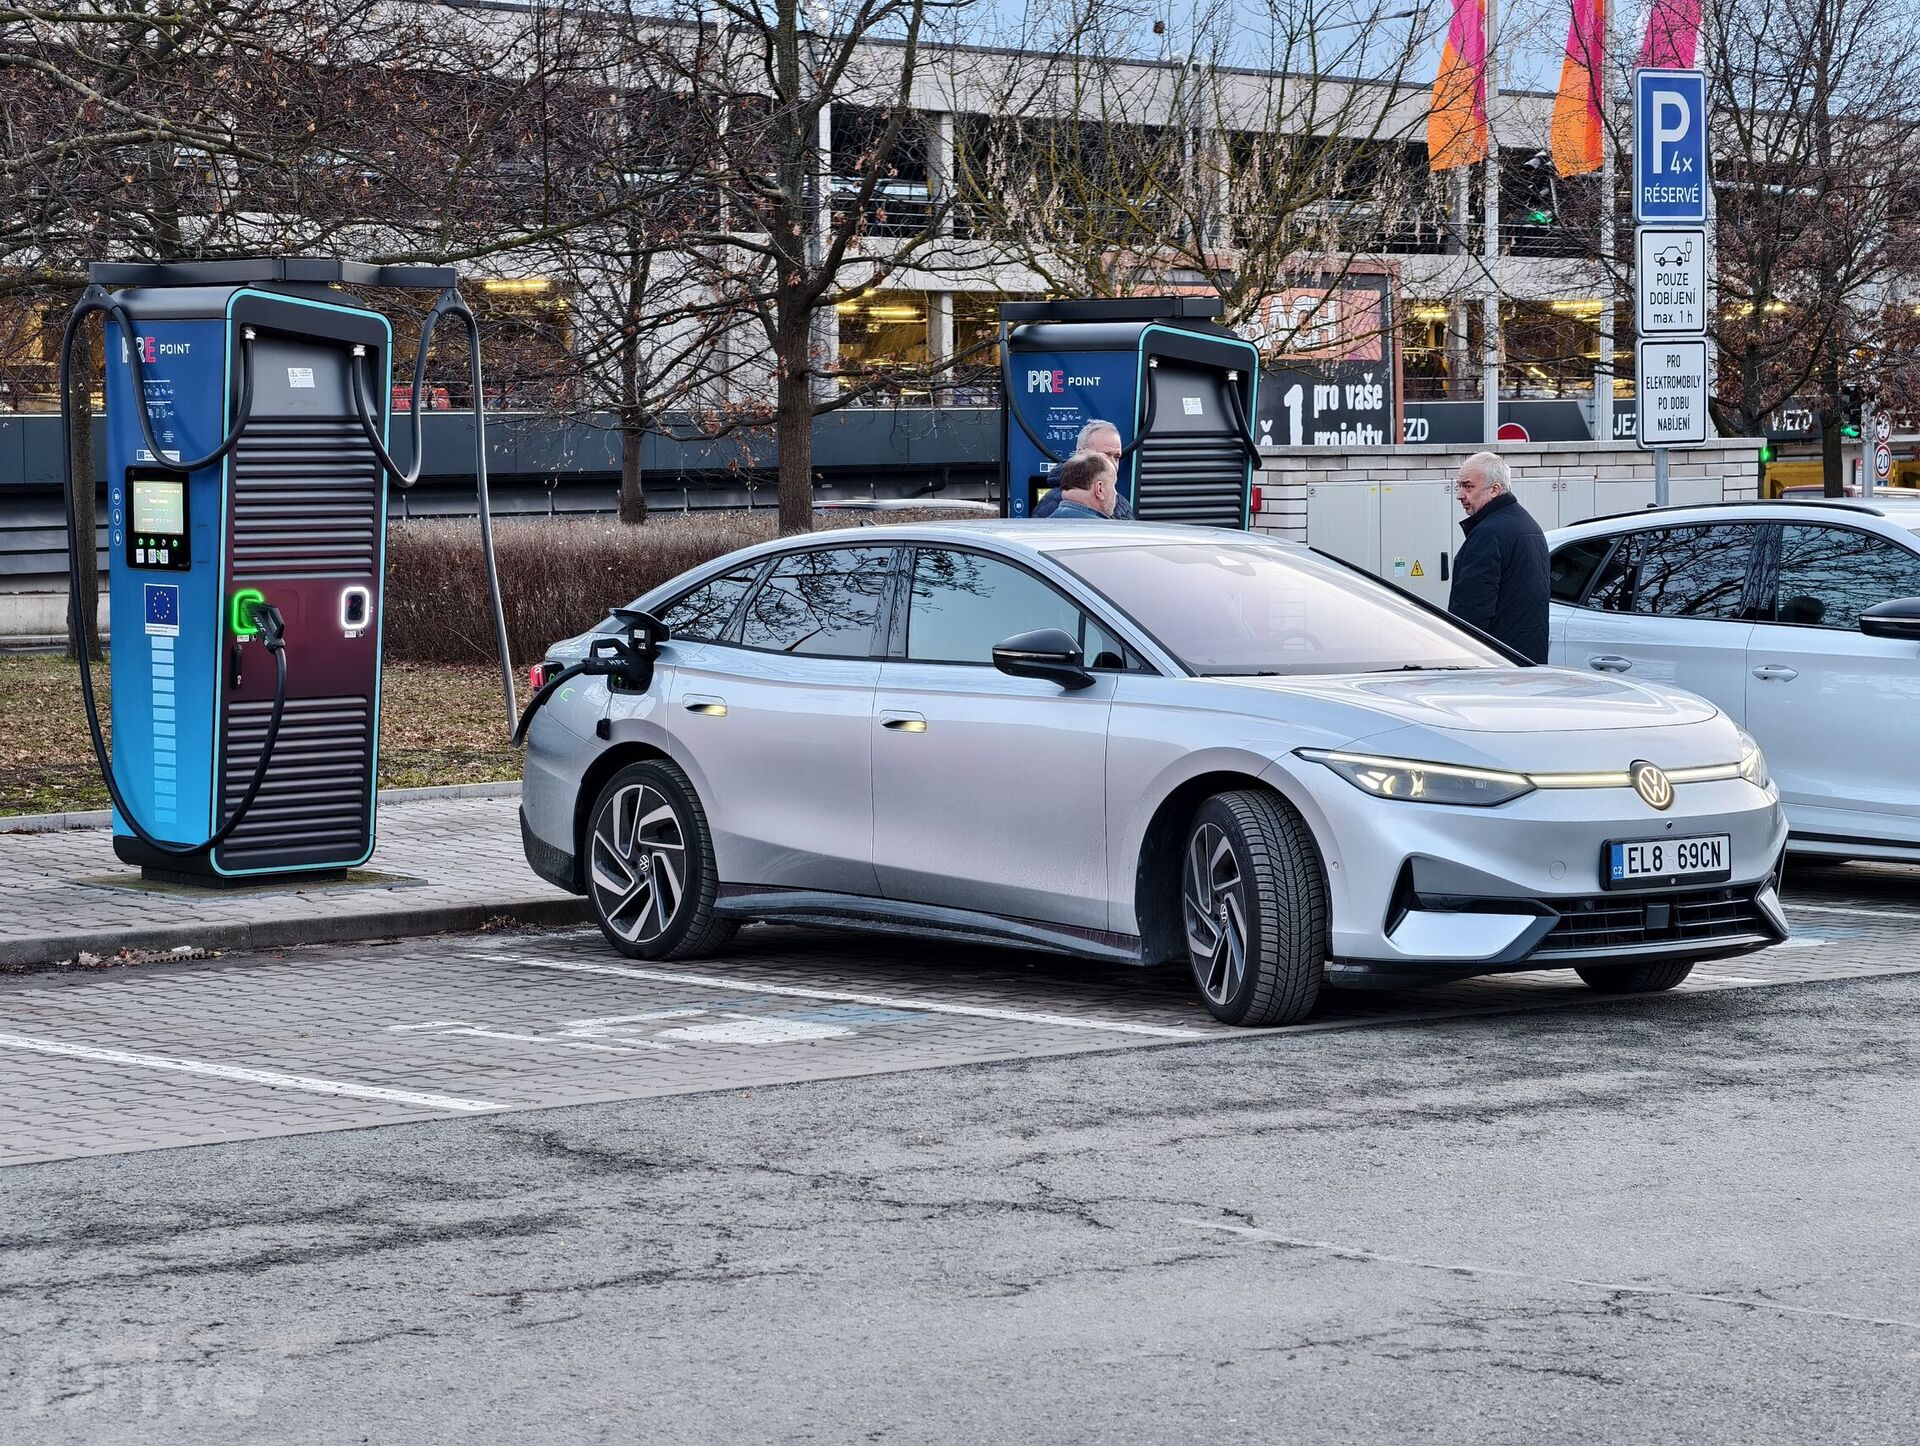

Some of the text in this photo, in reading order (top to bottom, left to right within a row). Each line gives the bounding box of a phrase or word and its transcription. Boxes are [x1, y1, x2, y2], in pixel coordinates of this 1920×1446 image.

[1653, 91, 1691, 174] P
[1670, 151, 1693, 174] 4x
[1644, 183, 1699, 203] RÉSERVÉ
[1656, 272, 1689, 286] POUZE
[1649, 287, 1696, 305] DOBÍJENÍ
[1653, 311, 1693, 324] max. 1 h
[160, 343, 191, 355] POINT
[1666, 355, 1681, 368] PRO
[1027, 370, 1101, 393] PRE POINT
[1646, 375, 1701, 390] ELEKTROMOBILY
[1313, 372, 1383, 419] pro vaše
[1658, 396, 1690, 410] PO DOBU
[1283, 384, 1304, 446] 1
[1657, 414, 1690, 431] NABÍJENÍ
[1877, 453, 1889, 469] 20
[1628, 840, 1721, 874] EL8 69CN
[1613, 866, 1622, 875] CZ
